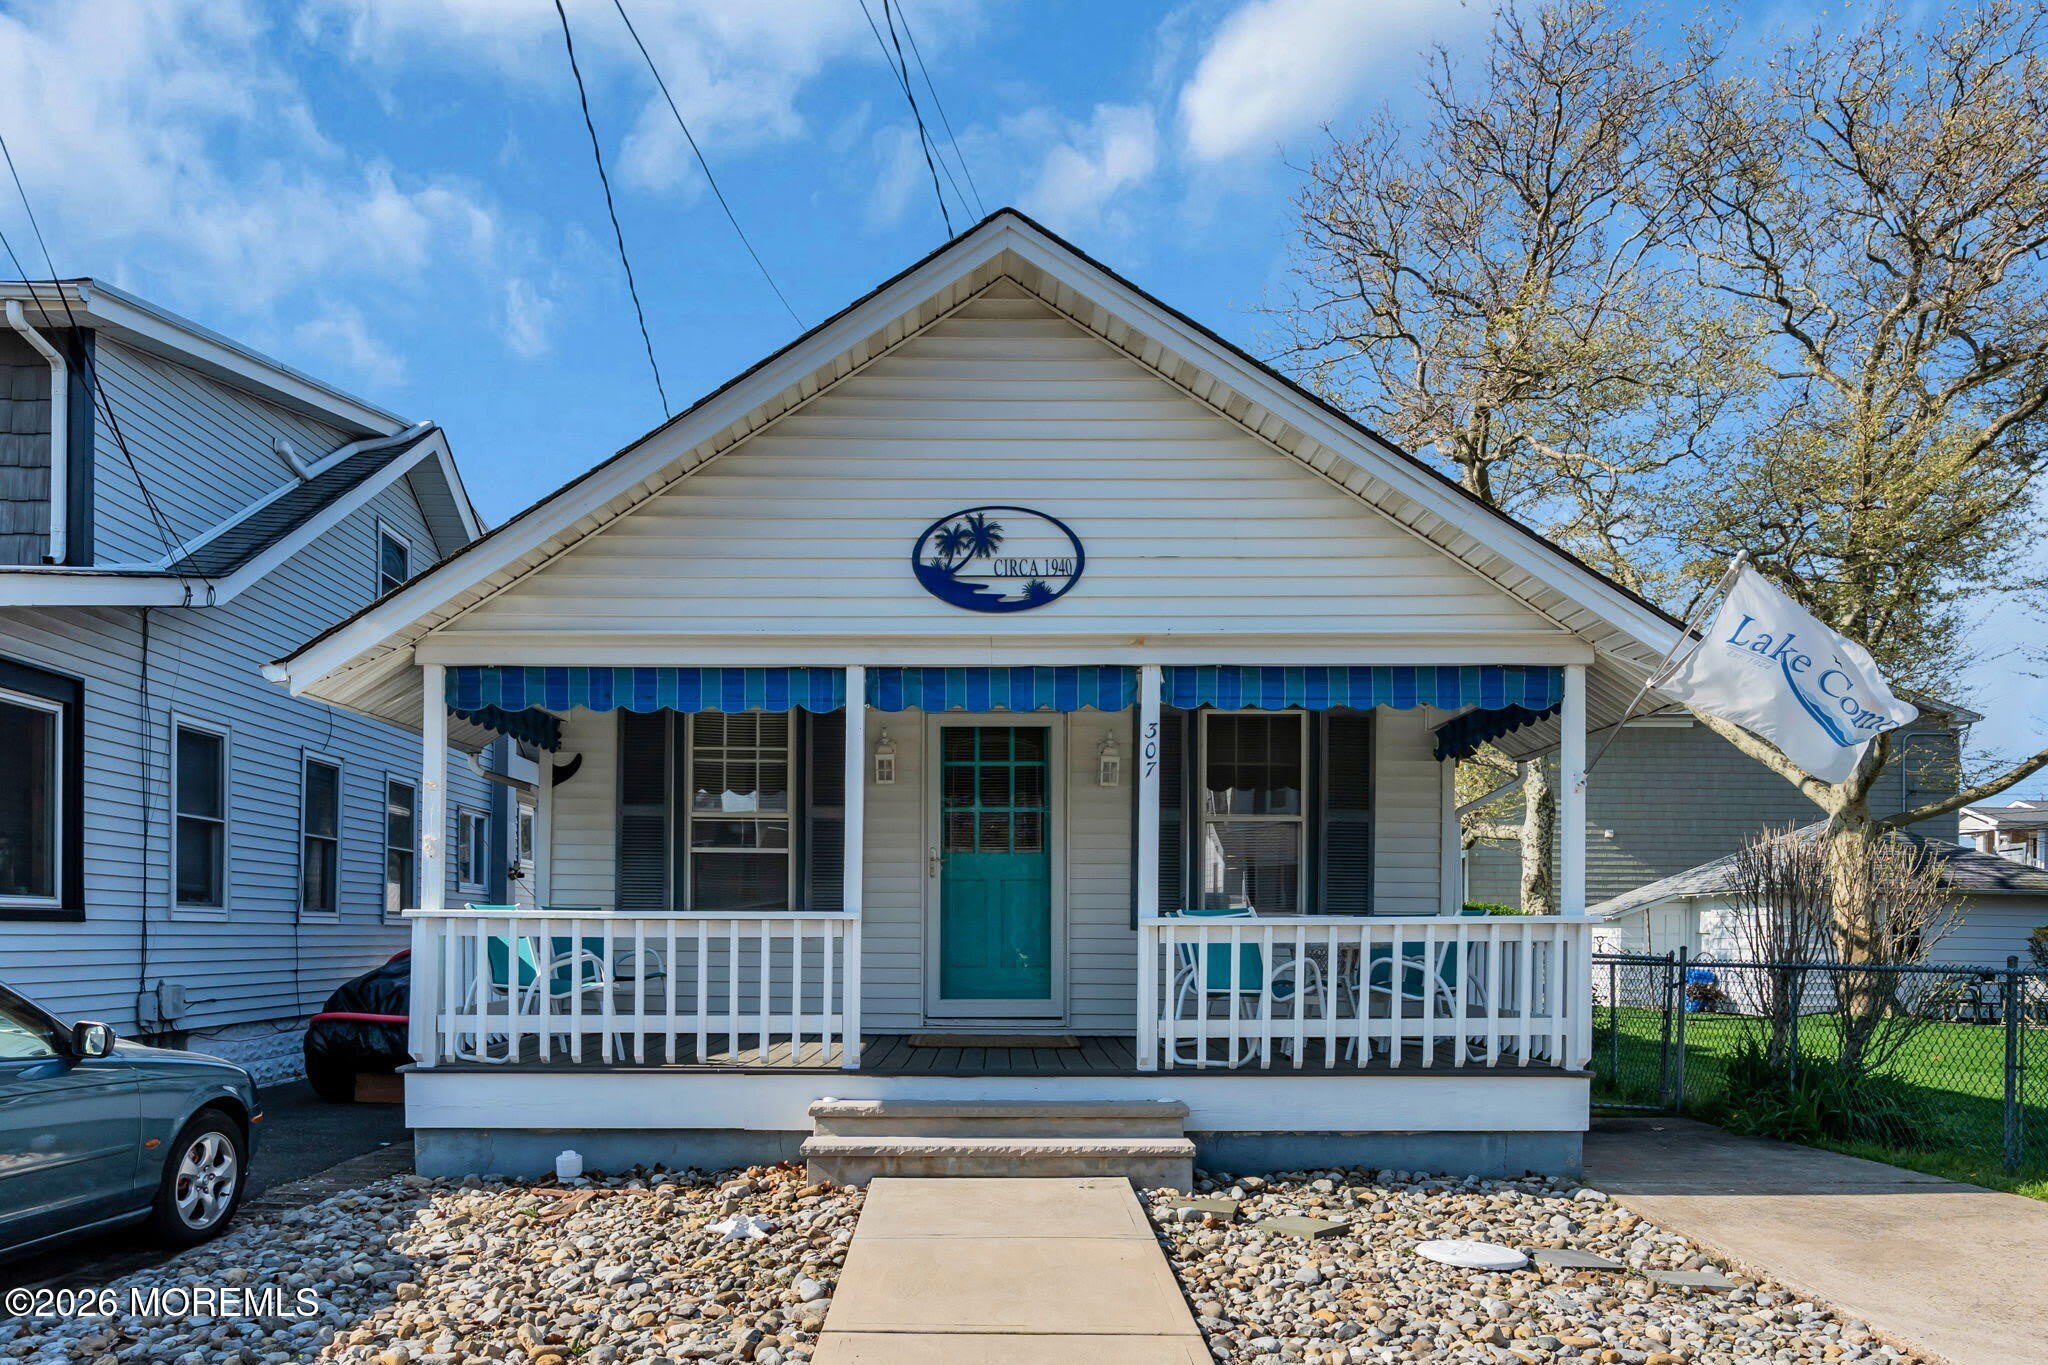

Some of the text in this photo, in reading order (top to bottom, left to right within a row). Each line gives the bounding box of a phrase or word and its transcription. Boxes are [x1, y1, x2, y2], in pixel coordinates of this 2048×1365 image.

[994, 559, 1073, 577] CIRCA 1940
[1726, 614, 1812, 673] Lake
[1144, 722, 1158, 778] 307
